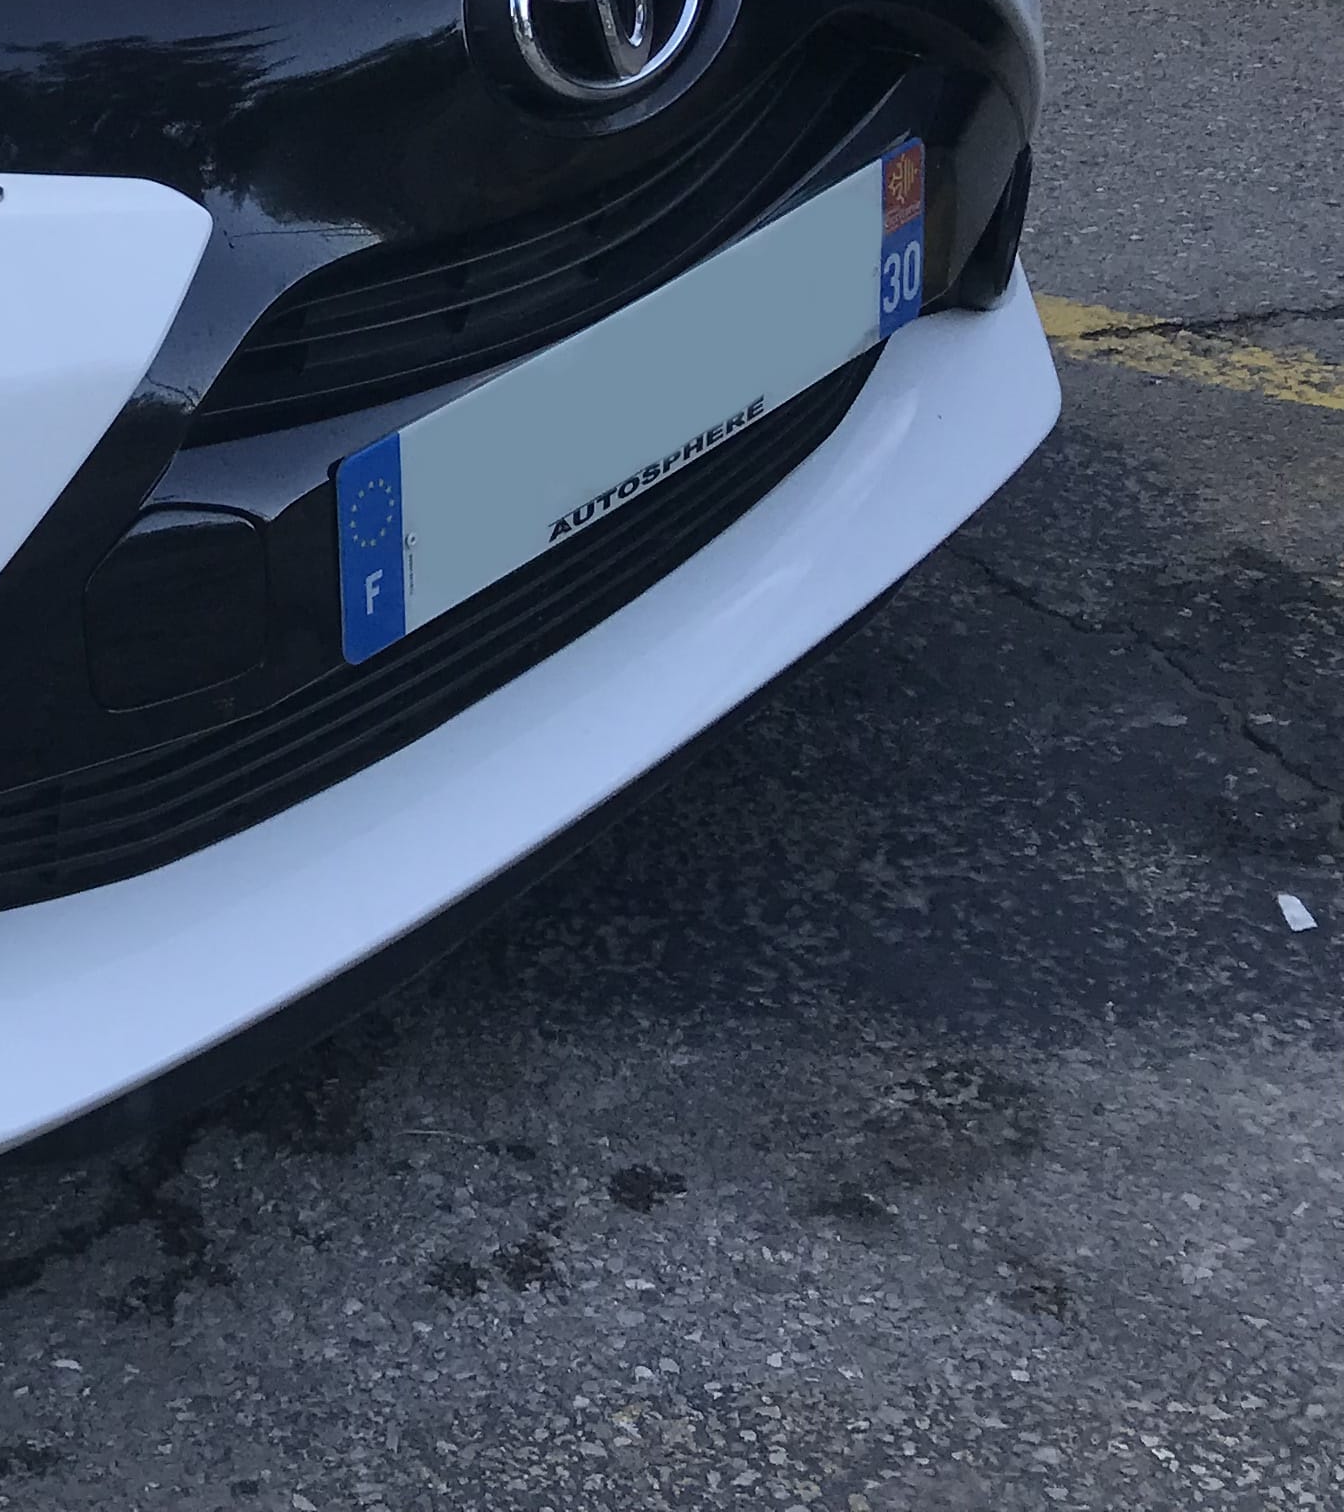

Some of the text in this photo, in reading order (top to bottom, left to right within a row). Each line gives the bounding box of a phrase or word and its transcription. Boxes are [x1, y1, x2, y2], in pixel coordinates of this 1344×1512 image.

[882, 239, 921, 313] 30
[548, 393, 765, 543] AUTOSPHERE
[365, 568, 384, 616] F
